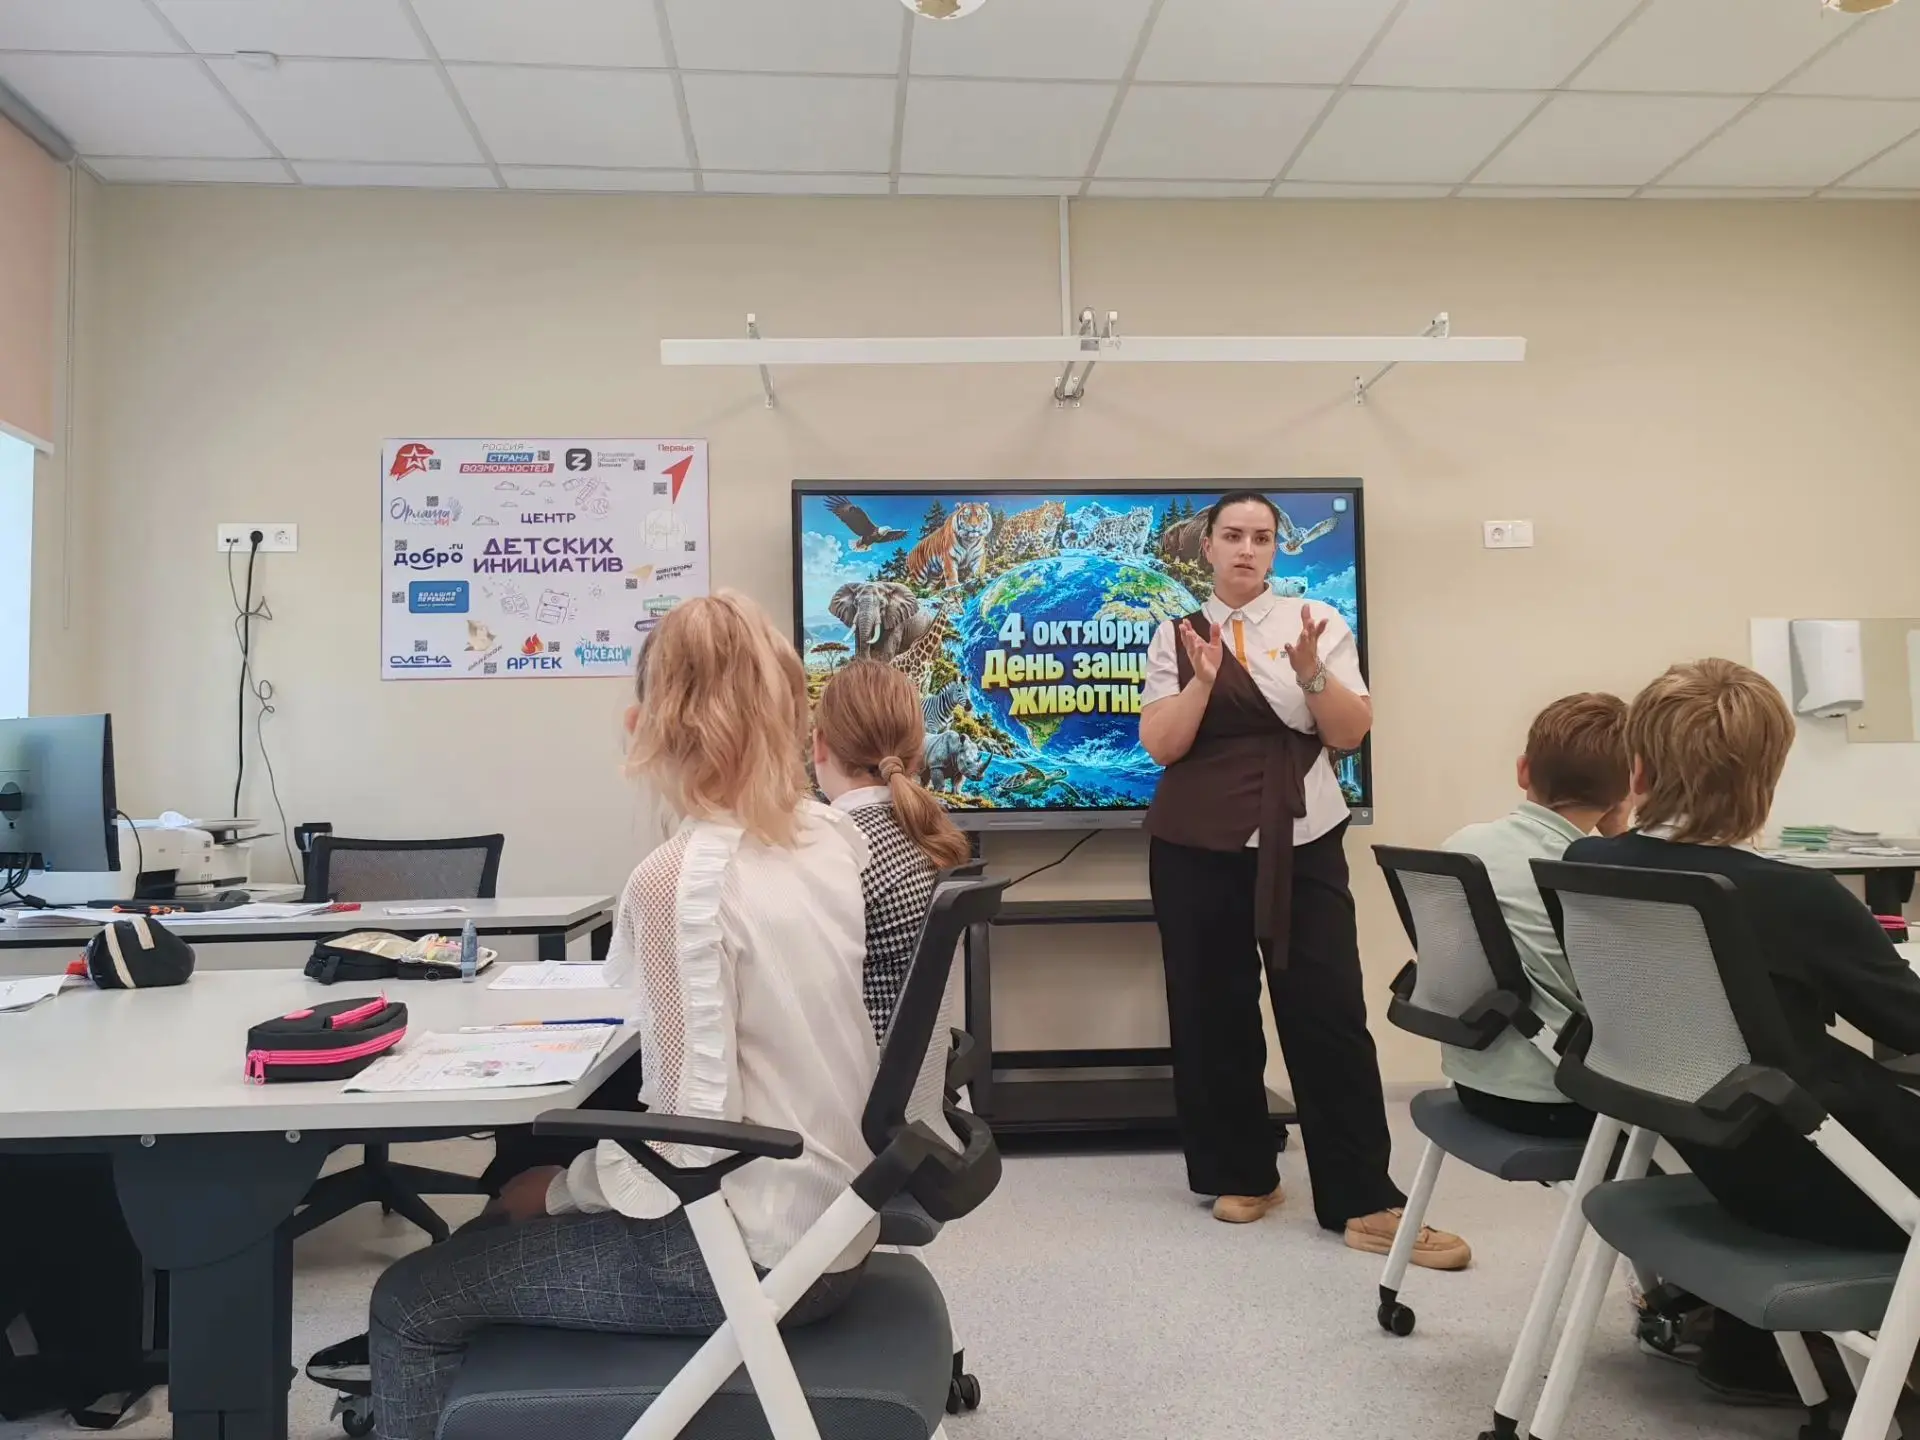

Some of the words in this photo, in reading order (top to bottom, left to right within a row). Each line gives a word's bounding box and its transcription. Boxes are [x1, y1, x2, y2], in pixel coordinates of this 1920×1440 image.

[482, 443, 524, 451] РОССИЯ
[658, 444, 695, 452] Первые
[489, 454, 530, 462] СТРАНА
[462, 463, 551, 472] ВОЗМОЖНОСТЕЙ
[520, 512, 576, 524] ЦЕНТР
[483, 537, 614, 555] ДЕТСКИХ
[393, 547, 463, 568] добро
[473, 556, 624, 574] ИНИЦИАТИВ
[999, 612, 1026, 648] 4
[1032, 613, 1150, 649] октября
[390, 655, 451, 664] СМЕНА
[583, 648, 623, 660] ОКЕАН
[506, 656, 562, 670] АРТЕК
[981, 649, 1065, 689] День
